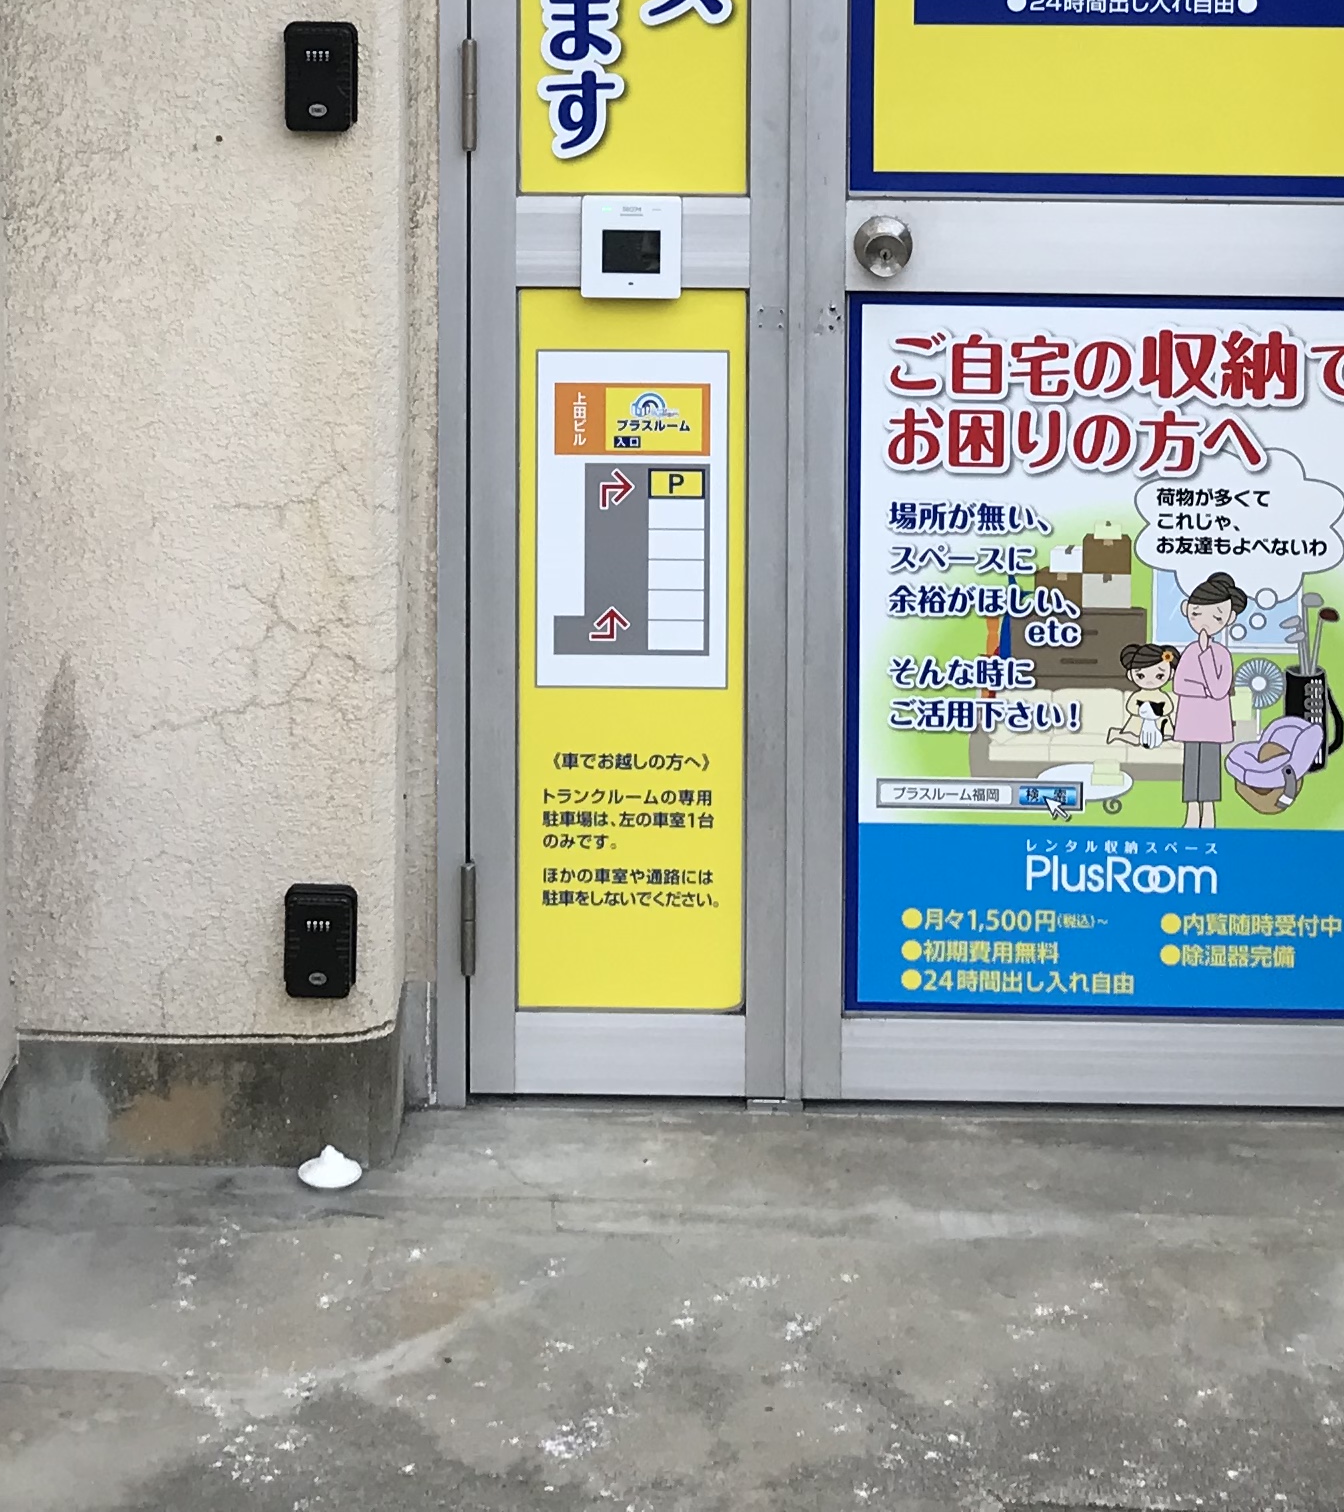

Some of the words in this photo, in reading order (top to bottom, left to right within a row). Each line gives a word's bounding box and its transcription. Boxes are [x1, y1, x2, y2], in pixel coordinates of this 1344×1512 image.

[573, 391, 587, 446] 上田ビル
[617, 420, 690, 431] プラスルーム
[616, 437, 639, 447] 入口
[887, 407, 1263, 472] お困りの方へ
[669, 474, 684, 494] P
[1156, 488, 1270, 508] 荷物が多くて
[888, 502, 1051, 534] 場所が無い、
[1156, 513, 1241, 532] これじゃ、
[1156, 537, 1328, 556] お友達もよべないわ
[889, 545, 1034, 572] スペースに
[889, 586, 1080, 617] 余裕がほしい、
[1027, 622, 1081, 644] etc
[889, 658, 1034, 688] そんな時に
[543, 788, 712, 806] トランクルームの専用
[894, 787, 1000, 803] プラスルーム福岡
[543, 834, 617, 850] のみです。
[1027, 839, 1218, 855] レンタル収納スペース
[543, 868, 713, 885] ほかの車室や通路には
[1027, 856, 1217, 894] PlusRoom
[542, 890, 719, 908] 駐車をしないでください。
[1182, 913, 1342, 938] 内覧随時受付中
[923, 940, 1059, 964] 初期費用無料
[1182, 945, 1295, 968] 除湿器完備
[924, 970, 1135, 995] 24時間出し入れ自由
